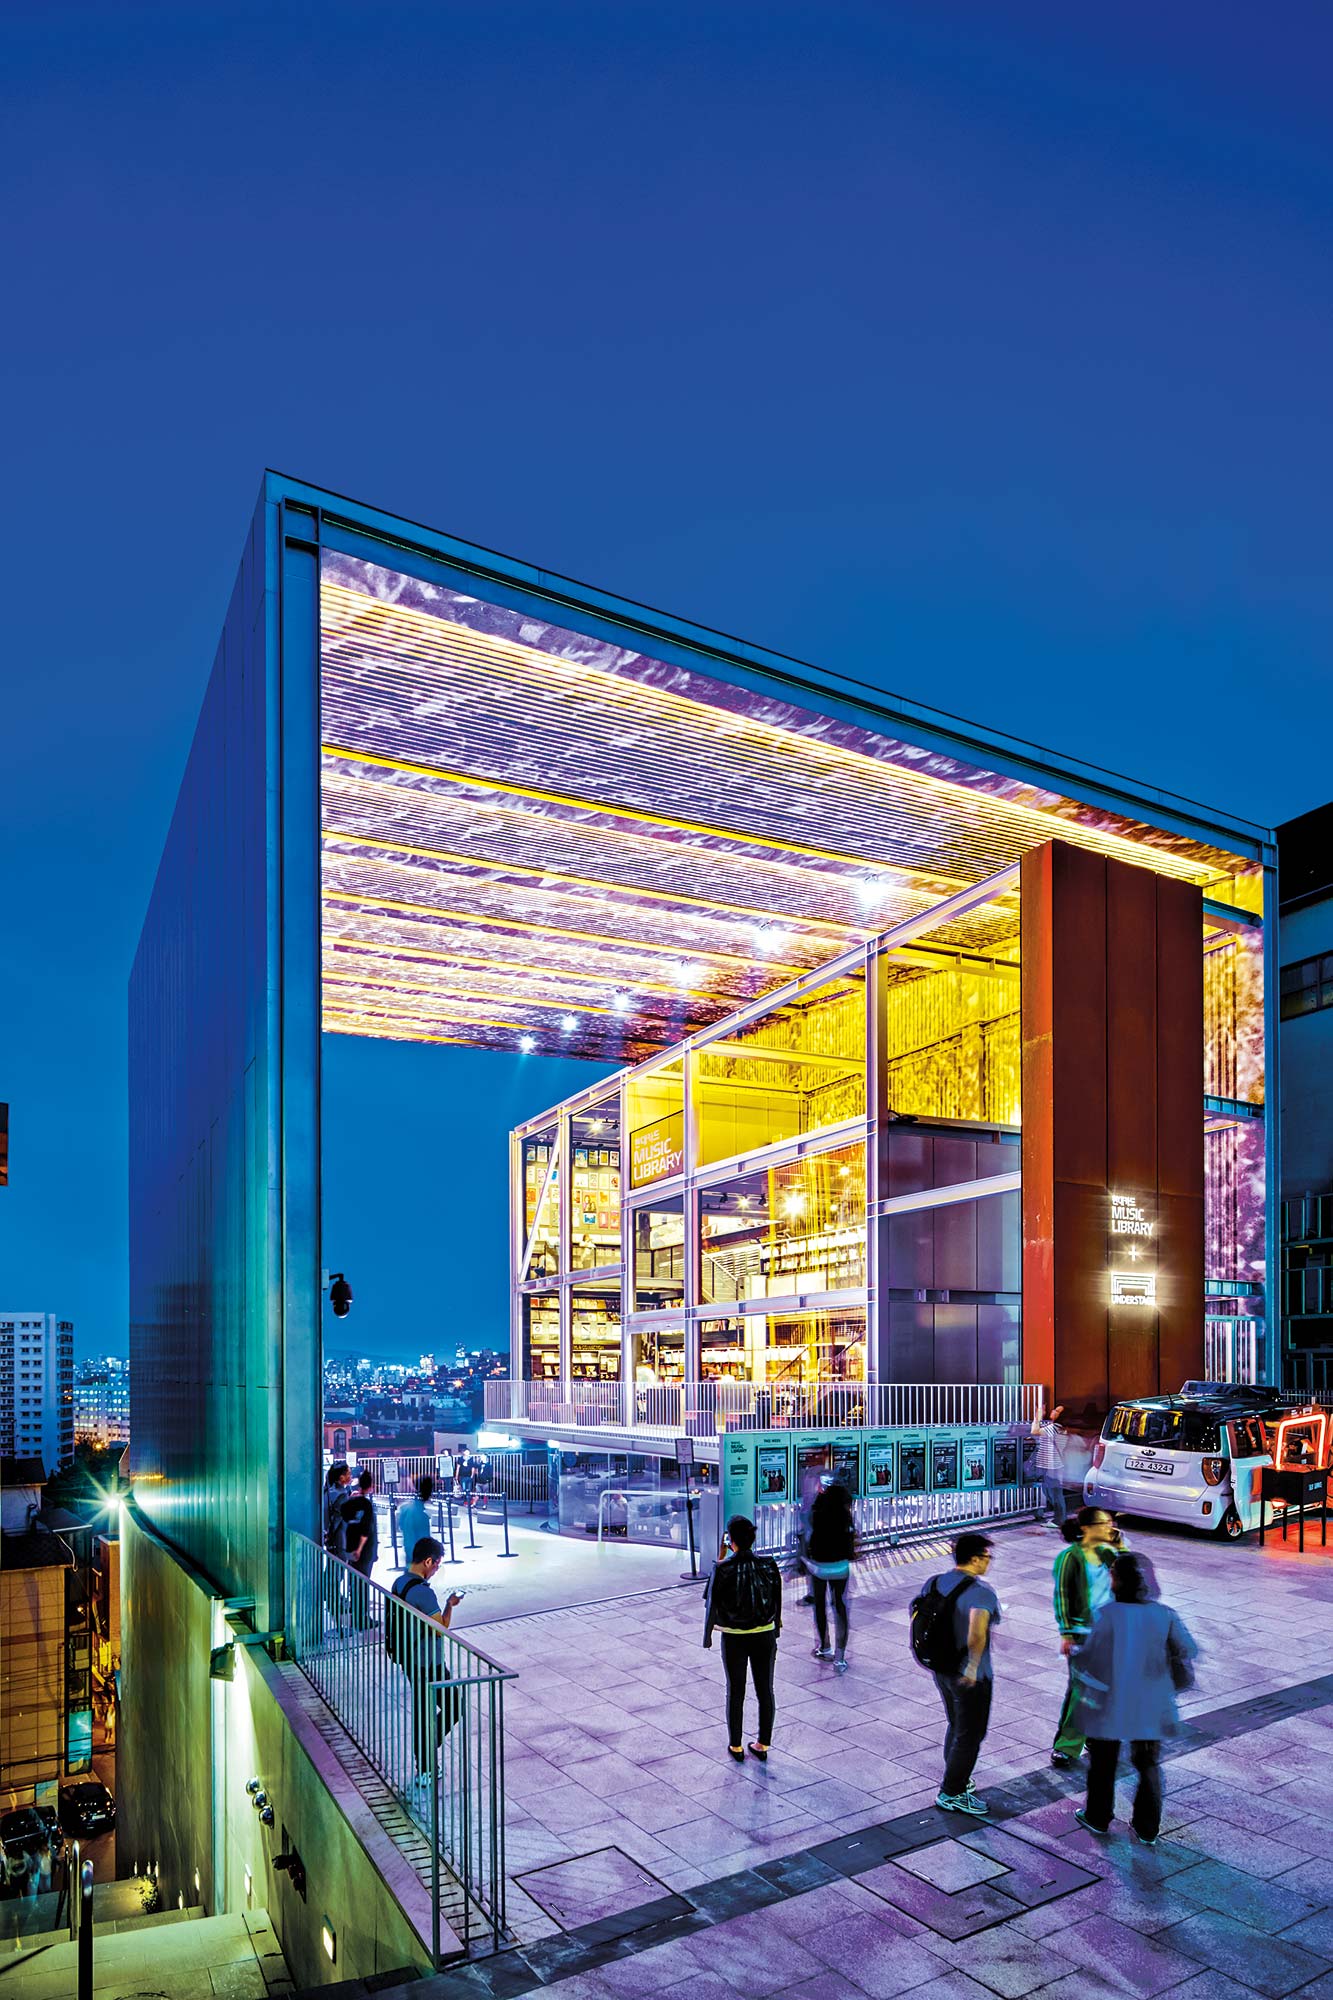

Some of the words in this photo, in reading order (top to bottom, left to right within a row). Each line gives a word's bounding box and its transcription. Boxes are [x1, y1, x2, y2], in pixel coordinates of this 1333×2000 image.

[633, 1137, 672, 1165] MUSIC
[633, 1150, 683, 1181] LIBRARY
[1111, 1206, 1145, 1221] MUSIC
[1111, 1219, 1154, 1236] LIBRARY
[1111, 1294, 1156, 1306] UNDERST
[1147, 1463, 1168, 1472] 4324
